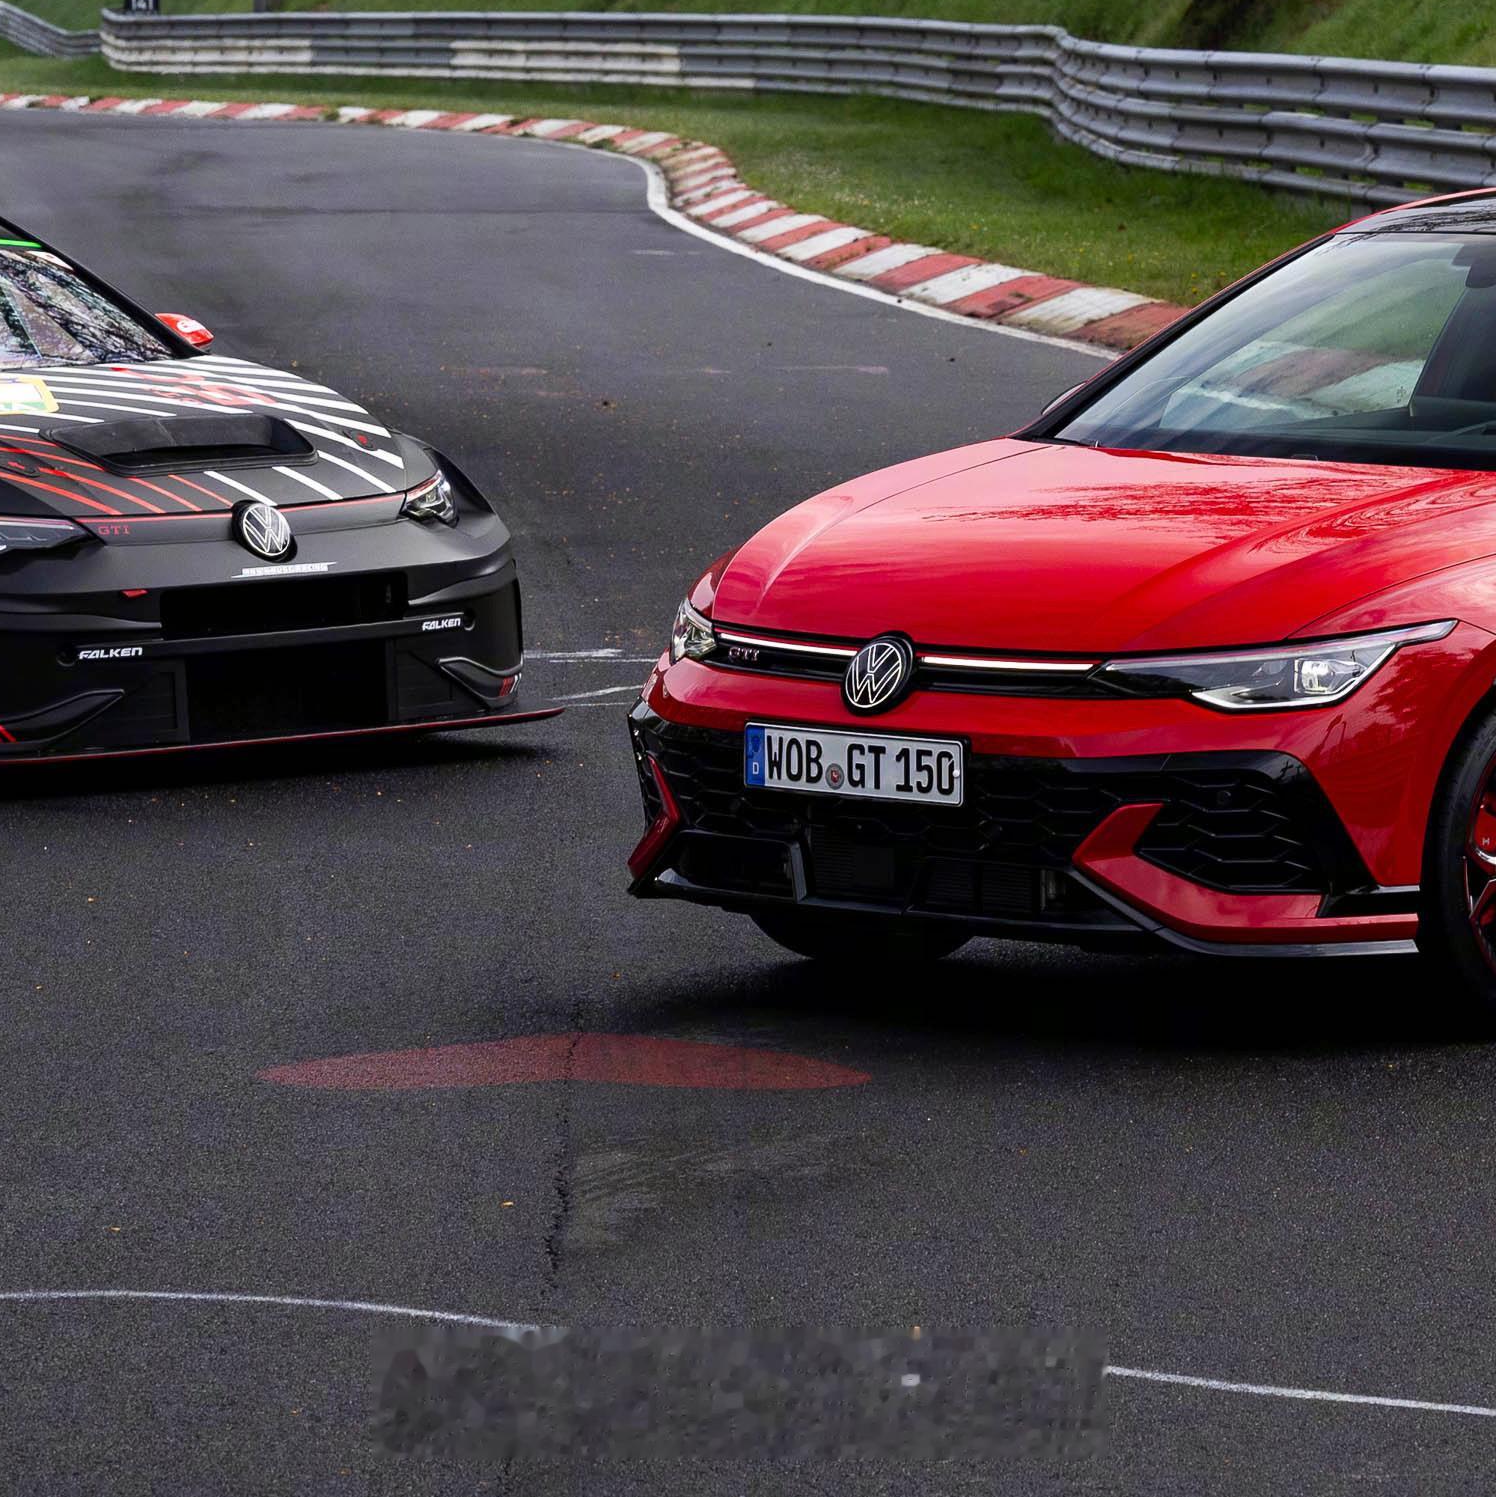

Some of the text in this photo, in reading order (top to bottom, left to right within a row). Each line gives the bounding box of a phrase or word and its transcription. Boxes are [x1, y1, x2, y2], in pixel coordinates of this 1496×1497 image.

[97, 525, 131, 535] GTI
[422, 617, 461, 631] FALKEN
[78, 647, 143, 659] FALKEN
[752, 762, 759, 774] D
[766, 734, 956, 796] WOB GT 150
